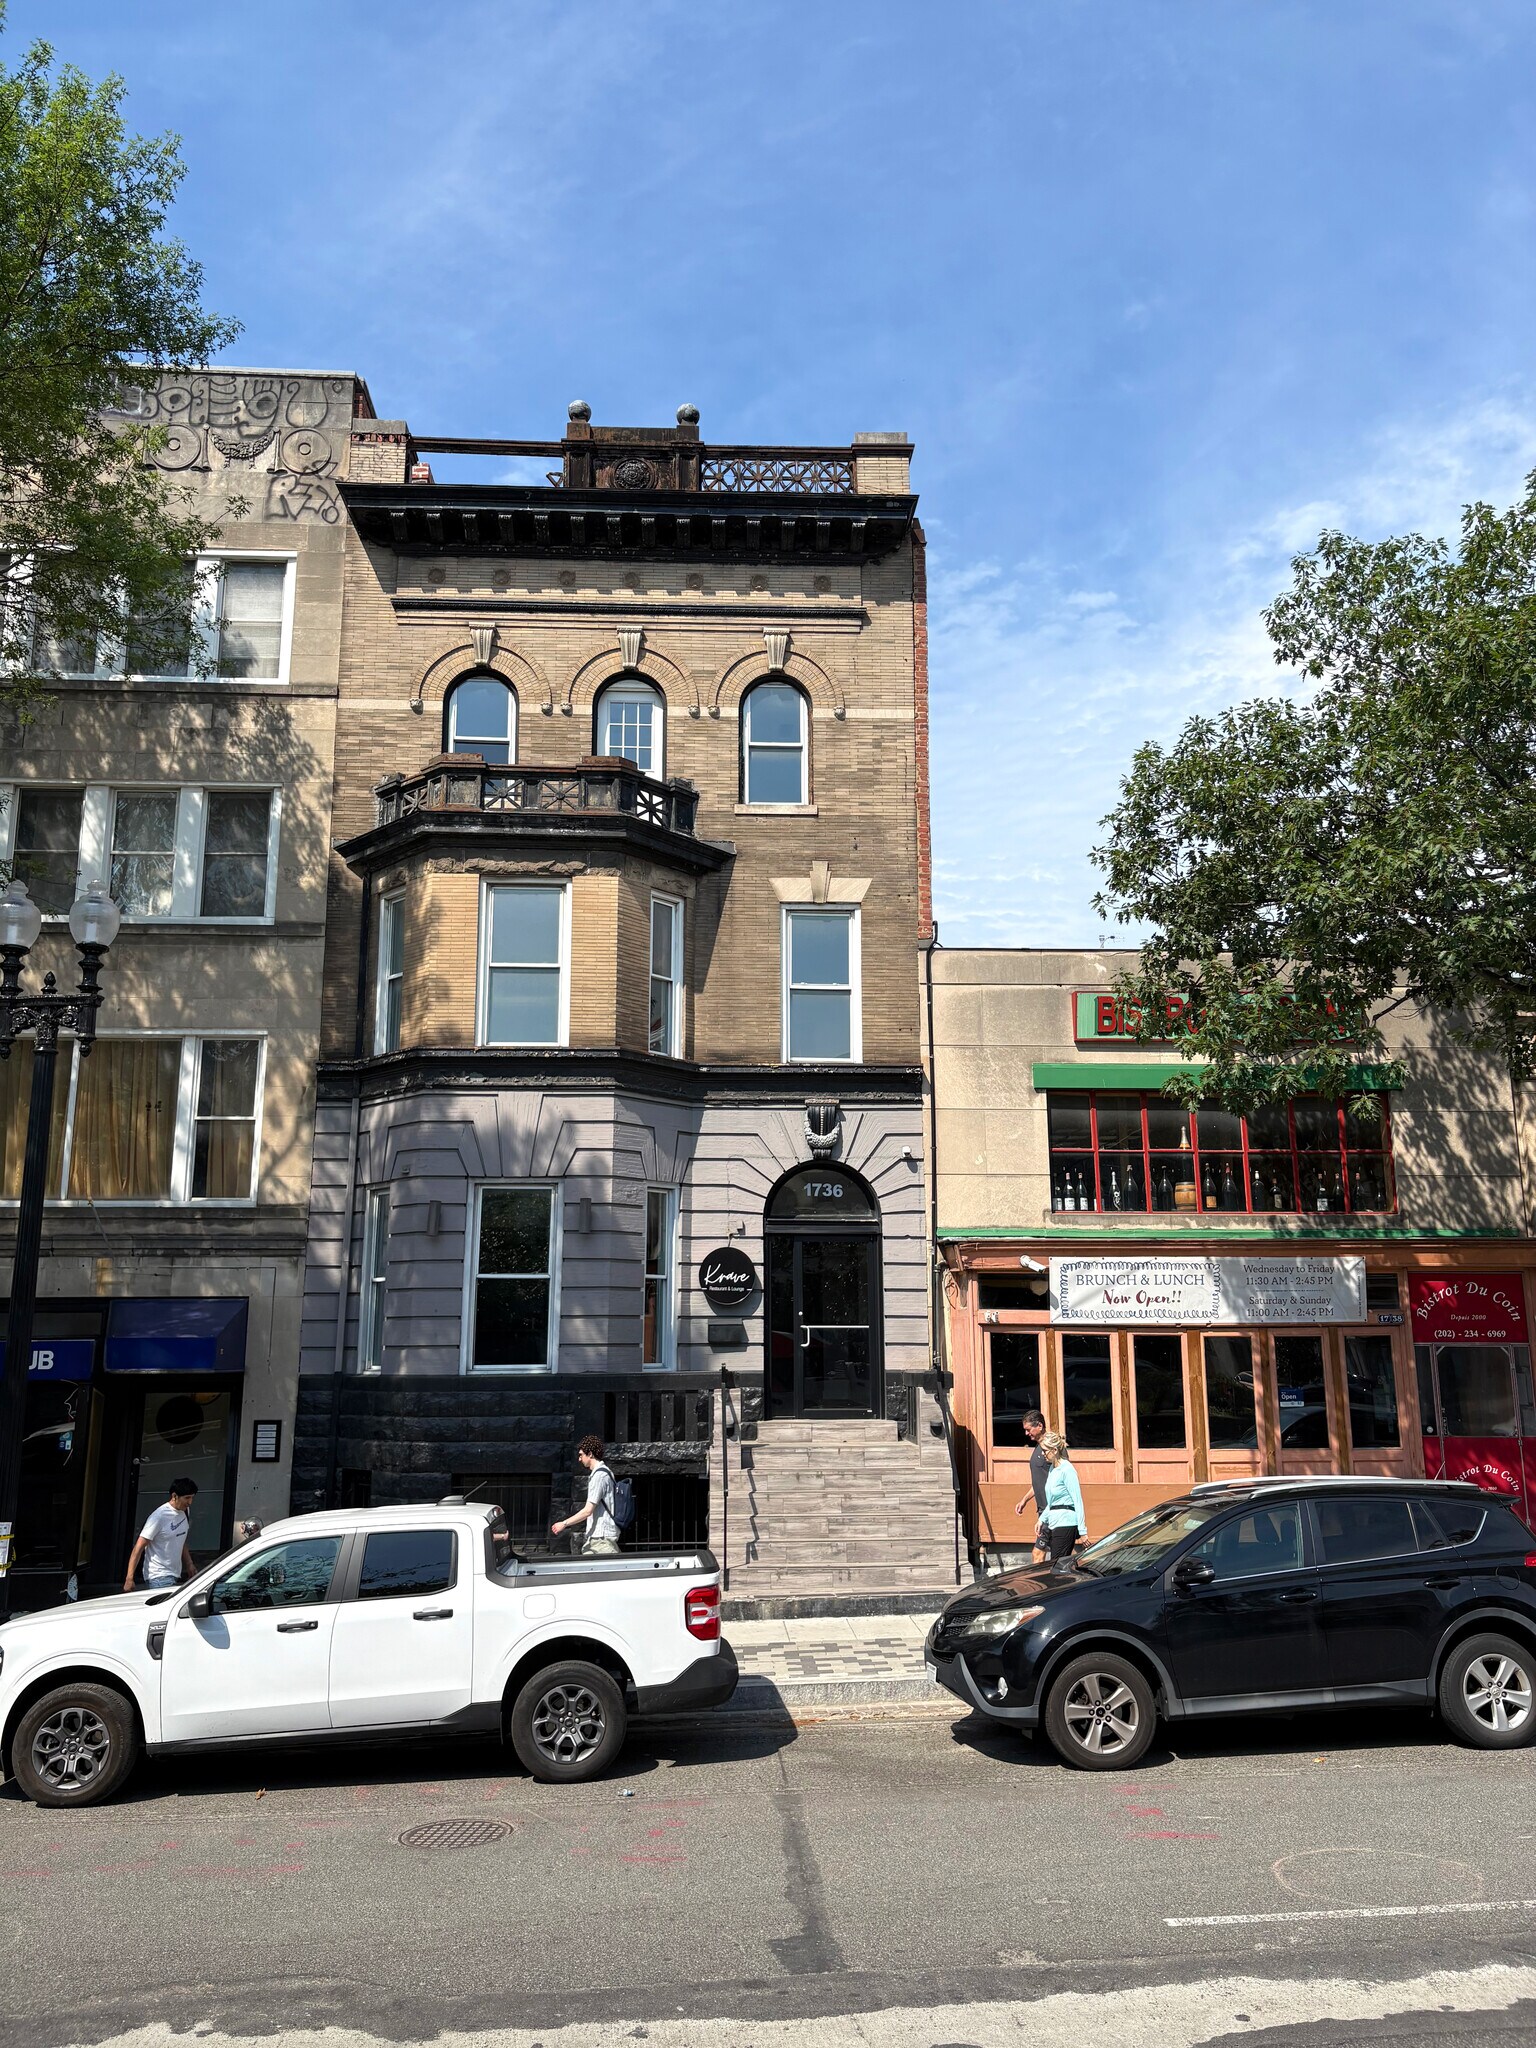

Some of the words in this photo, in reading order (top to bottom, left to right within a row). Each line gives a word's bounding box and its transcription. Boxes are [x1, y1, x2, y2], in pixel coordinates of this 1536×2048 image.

[803, 1183, 844, 1198] 1736
[704, 1263, 750, 1285] Krave
[1243, 1264, 1294, 1276] Wednesday
[1296, 1265, 1305, 1273] to
[1307, 1264, 1335, 1275] Friday
[1076, 1274, 1137, 1286] BRUNCH
[1140, 1274, 1150, 1286] &
[1154, 1274, 1205, 1286] LUNCH
[1246, 1277, 1268, 1286] 11:30
[1271, 1276, 1288, 1285] AM
[1295, 1276, 1316, 1285] 2:45
[1318, 1276, 1333, 1285] PM
[1102, 1289, 1131, 1304] Now
[1135, 1289, 1182, 1307] Open!!
[1248, 1296, 1287, 1306] Saturday
[1290, 1296, 1297, 1304] &
[1299, 1296, 1331, 1306] Sunday
[1416, 1283, 1460, 1320] Bistrot
[1465, 1281, 1488, 1296] Du
[1493, 1291, 1521, 1322] Coin
[1247, 1308, 1270, 1317] 11:00
[1272, 1308, 1289, 1317] AM
[1296, 1308, 1317, 1317] 2:45
[1319, 1308, 1334, 1316] PM
[1450, 1314, 1470, 1322] Depuis
[1434, 1330, 1456, 1339] (202)
[1464, 1330, 1479, 1338] 234
[1487, 1330, 1507, 1338] 6969
[1455, 1465, 1480, 1482] istrot
[1483, 1464, 1499, 1475] Du
[1501, 1470, 1520, 1492] Coin
